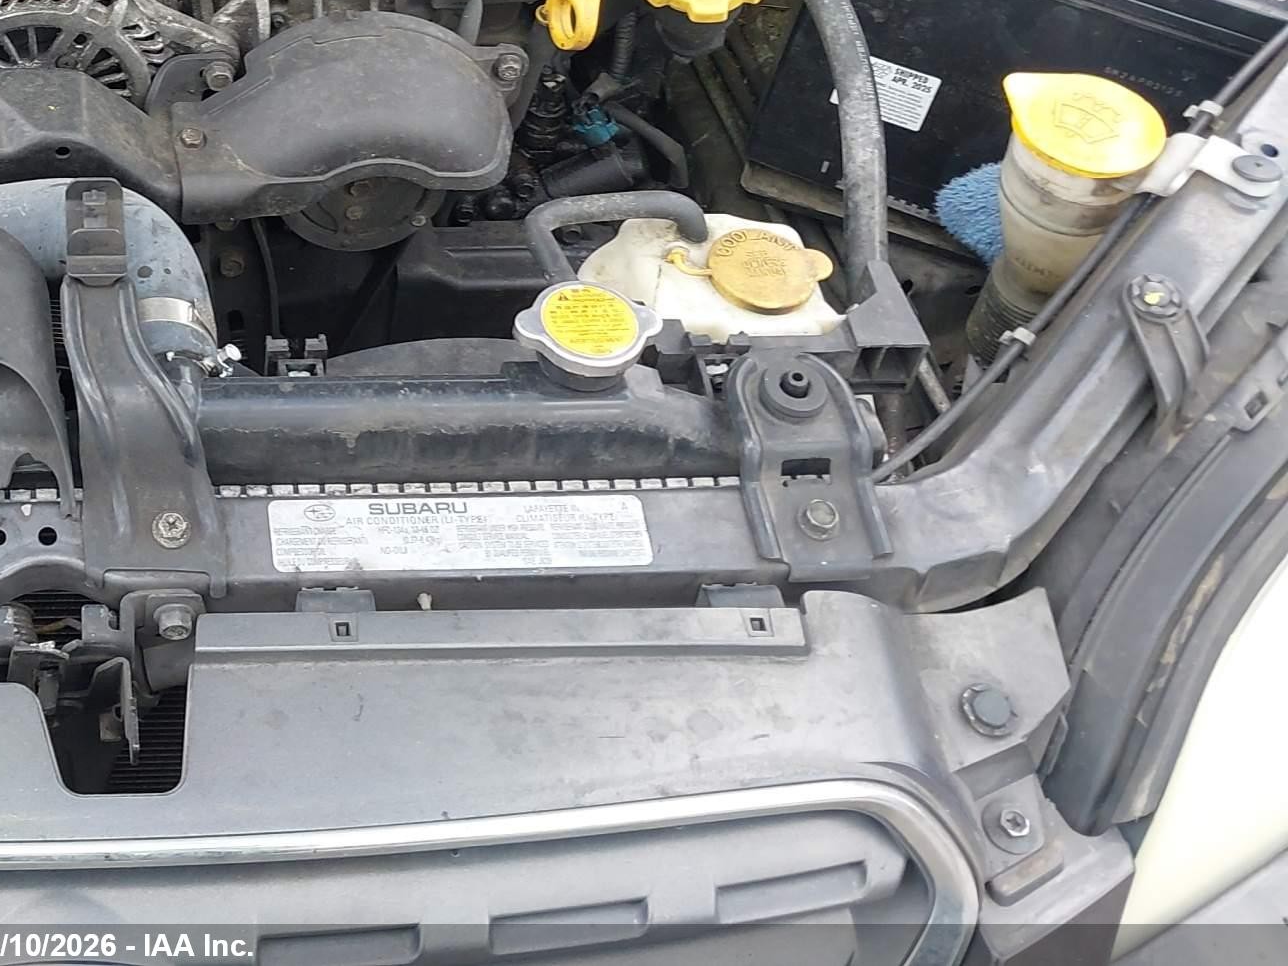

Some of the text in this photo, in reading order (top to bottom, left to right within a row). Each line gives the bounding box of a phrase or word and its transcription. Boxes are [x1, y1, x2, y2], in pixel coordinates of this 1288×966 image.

[368, 502, 468, 515] SUBARU
[346, 517, 363, 526] AIR
[366, 515, 439, 526] CONDITIONER
